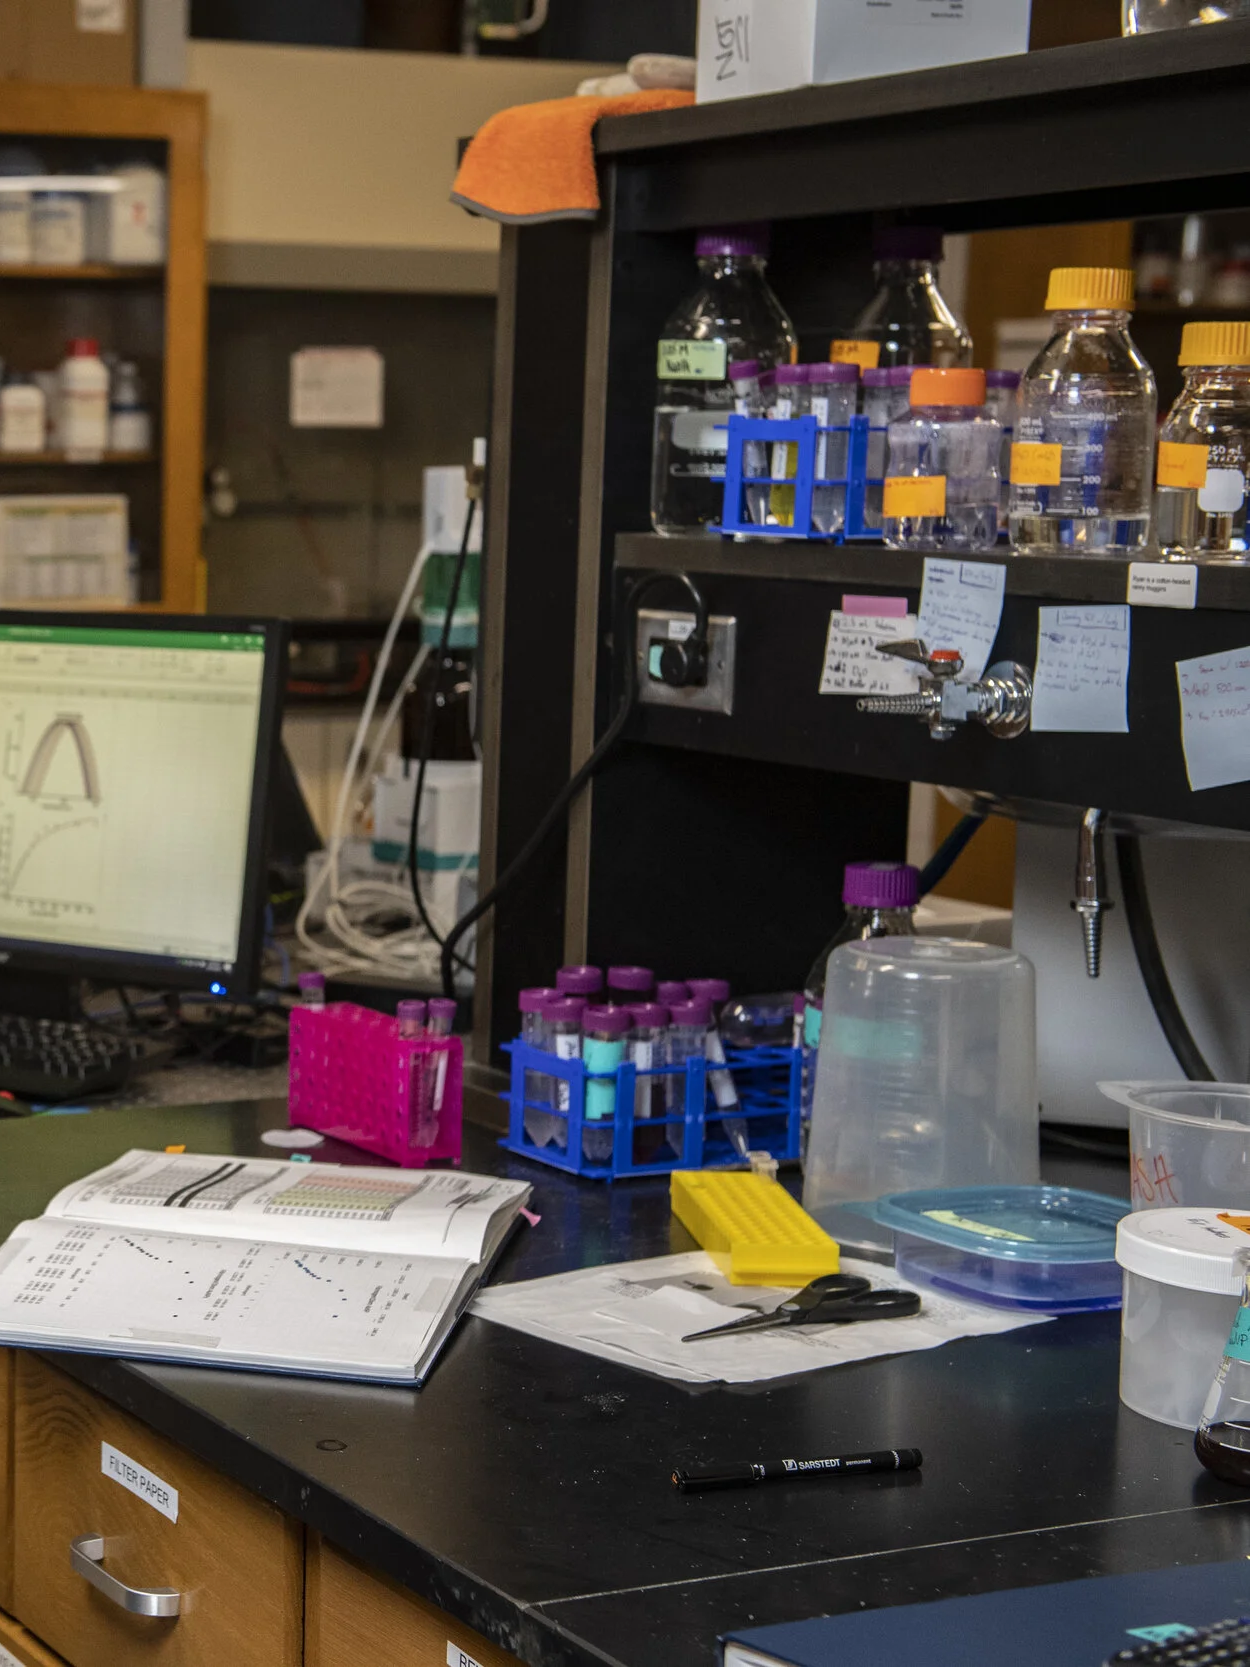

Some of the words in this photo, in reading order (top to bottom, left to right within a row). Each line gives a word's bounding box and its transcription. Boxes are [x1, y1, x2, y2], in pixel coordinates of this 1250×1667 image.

[1083, 475, 1101, 485] 200
[1082, 506, 1099, 516] 100
[798, 1458, 841, 1471] SARSTEDT
[845, 1458, 872, 1467] permanent
[109, 1454, 139, 1487] FILTER
[139, 1475, 170, 1509] PAPER
